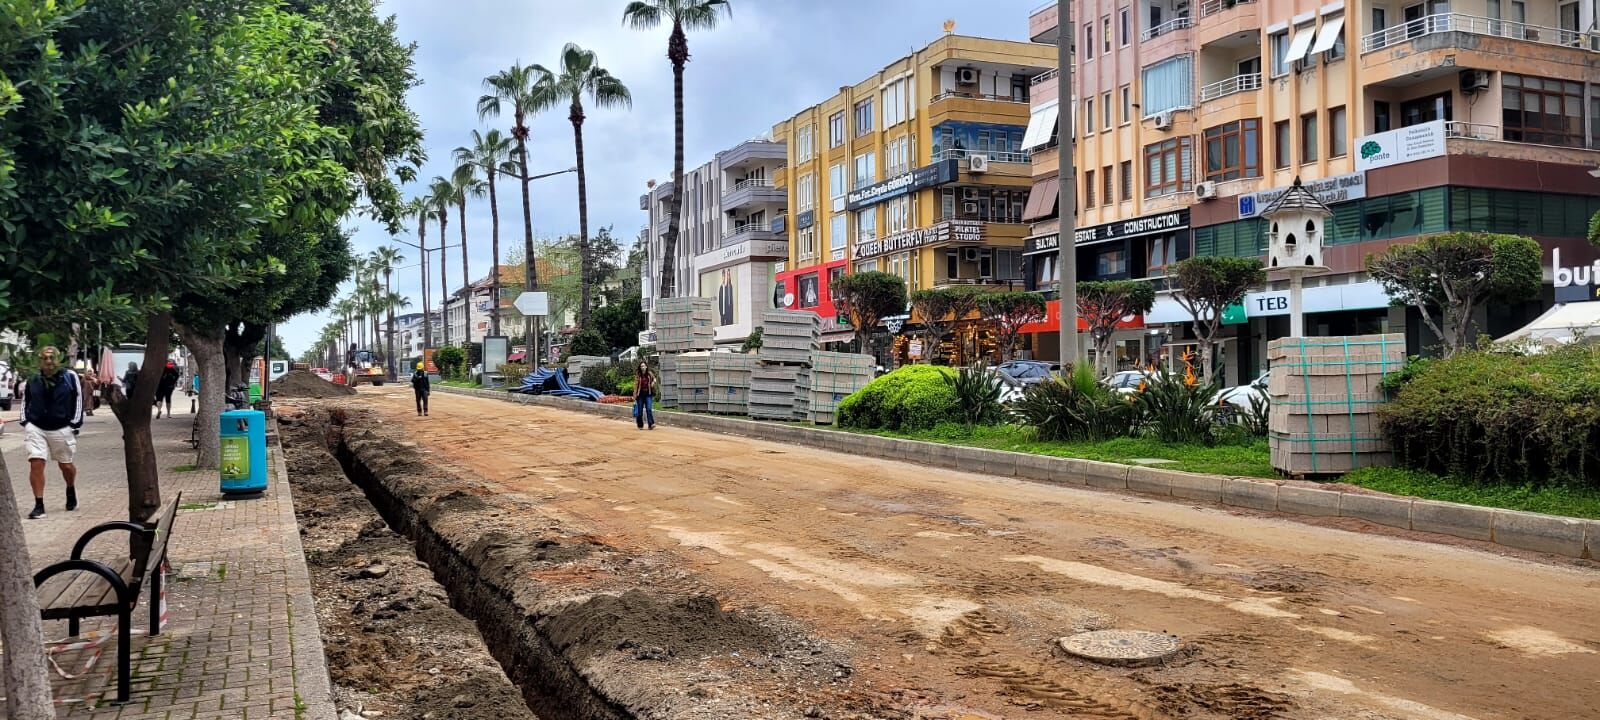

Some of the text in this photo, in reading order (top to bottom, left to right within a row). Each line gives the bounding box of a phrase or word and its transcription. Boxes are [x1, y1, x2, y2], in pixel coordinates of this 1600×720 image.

[1369, 152, 1390, 164] ponte
[1035, 213, 1180, 249] SULTAN ESTATE & CONSTRUCTION
[860, 242, 883, 256] QUEEN
[883, 230, 924, 252] BUTTERFLY
[1256, 296, 1288, 311] TEB
